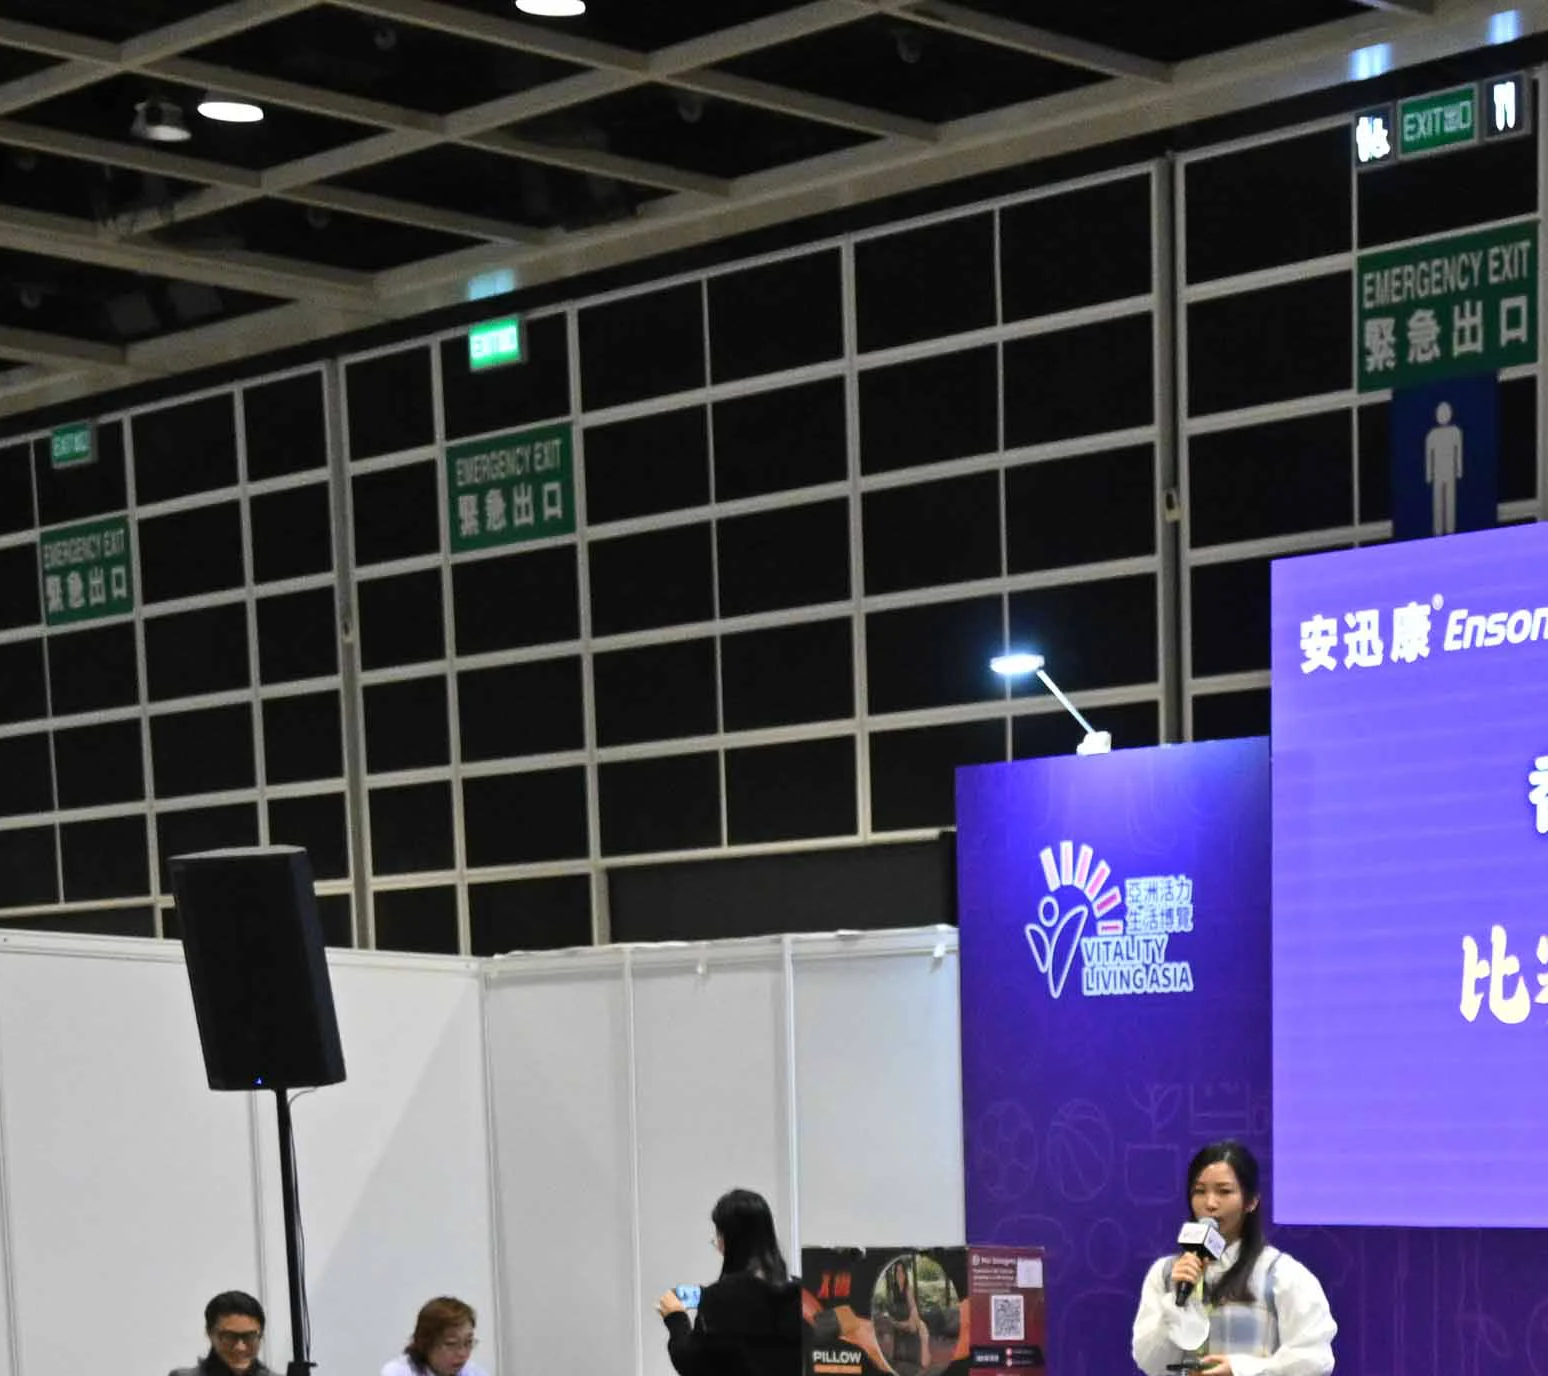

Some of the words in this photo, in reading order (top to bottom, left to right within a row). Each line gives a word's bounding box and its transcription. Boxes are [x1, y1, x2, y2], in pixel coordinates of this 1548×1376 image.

[1362, 252, 1482, 309] EMERGENCY
[1487, 240, 1532, 285] EXIT
[1363, 295, 1529, 373] 緊急出口
[455, 446, 531, 487] EMERGENCY
[534, 438, 562, 472] EXIT
[1125, 875, 1193, 904] 亞洲活力
[1081, 935, 1168, 965] VITALITY
[1083, 965, 1147, 996] LIVING
[1147, 961, 1194, 993] ASIA
[812, 1350, 863, 1364] PILLOW
